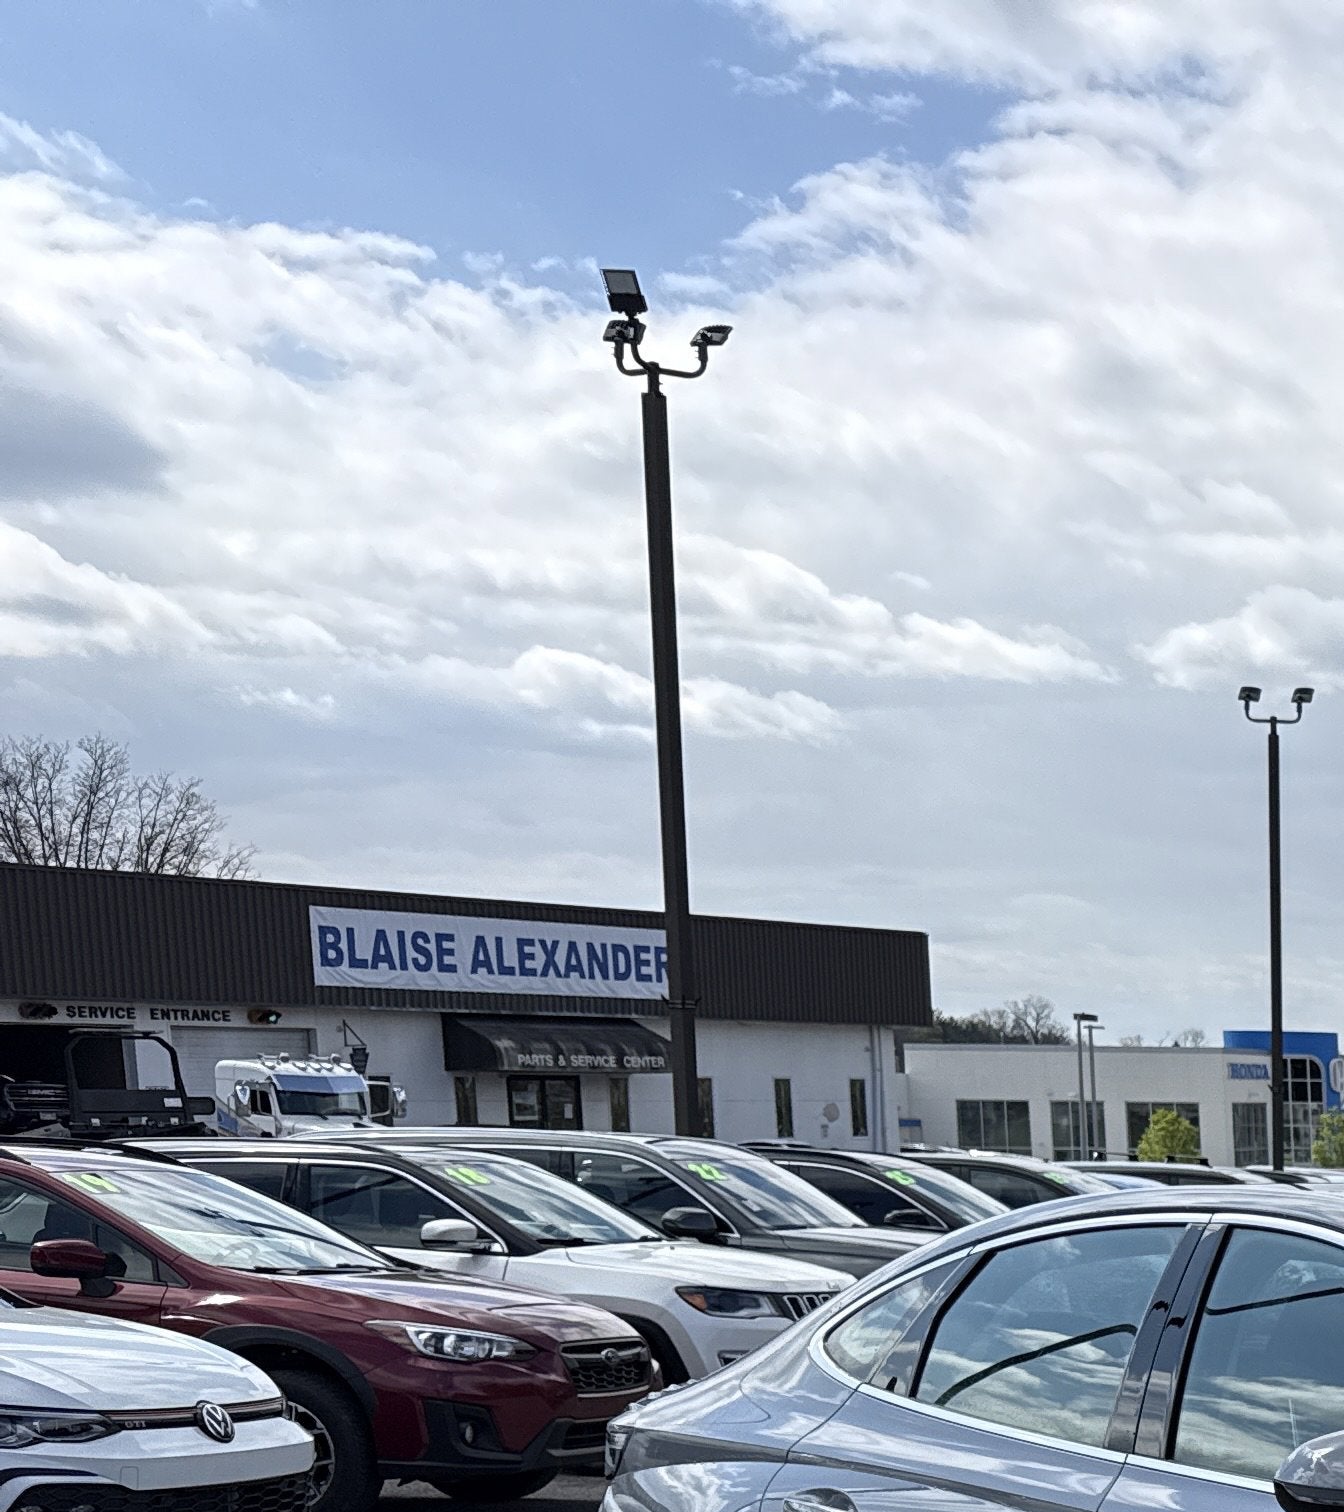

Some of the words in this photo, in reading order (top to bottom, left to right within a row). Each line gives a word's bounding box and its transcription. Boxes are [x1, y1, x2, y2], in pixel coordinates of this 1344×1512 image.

[317, 924, 458, 974] BLAISE
[66, 1005, 136, 1019] SERVICE
[150, 1007, 232, 1022] ENTRANCE
[517, 1054, 554, 1067] PARTS
[557, 1055, 567, 1067] &
[570, 1055, 617, 1068] SERVICE
[623, 1055, 665, 1068] CENTER
